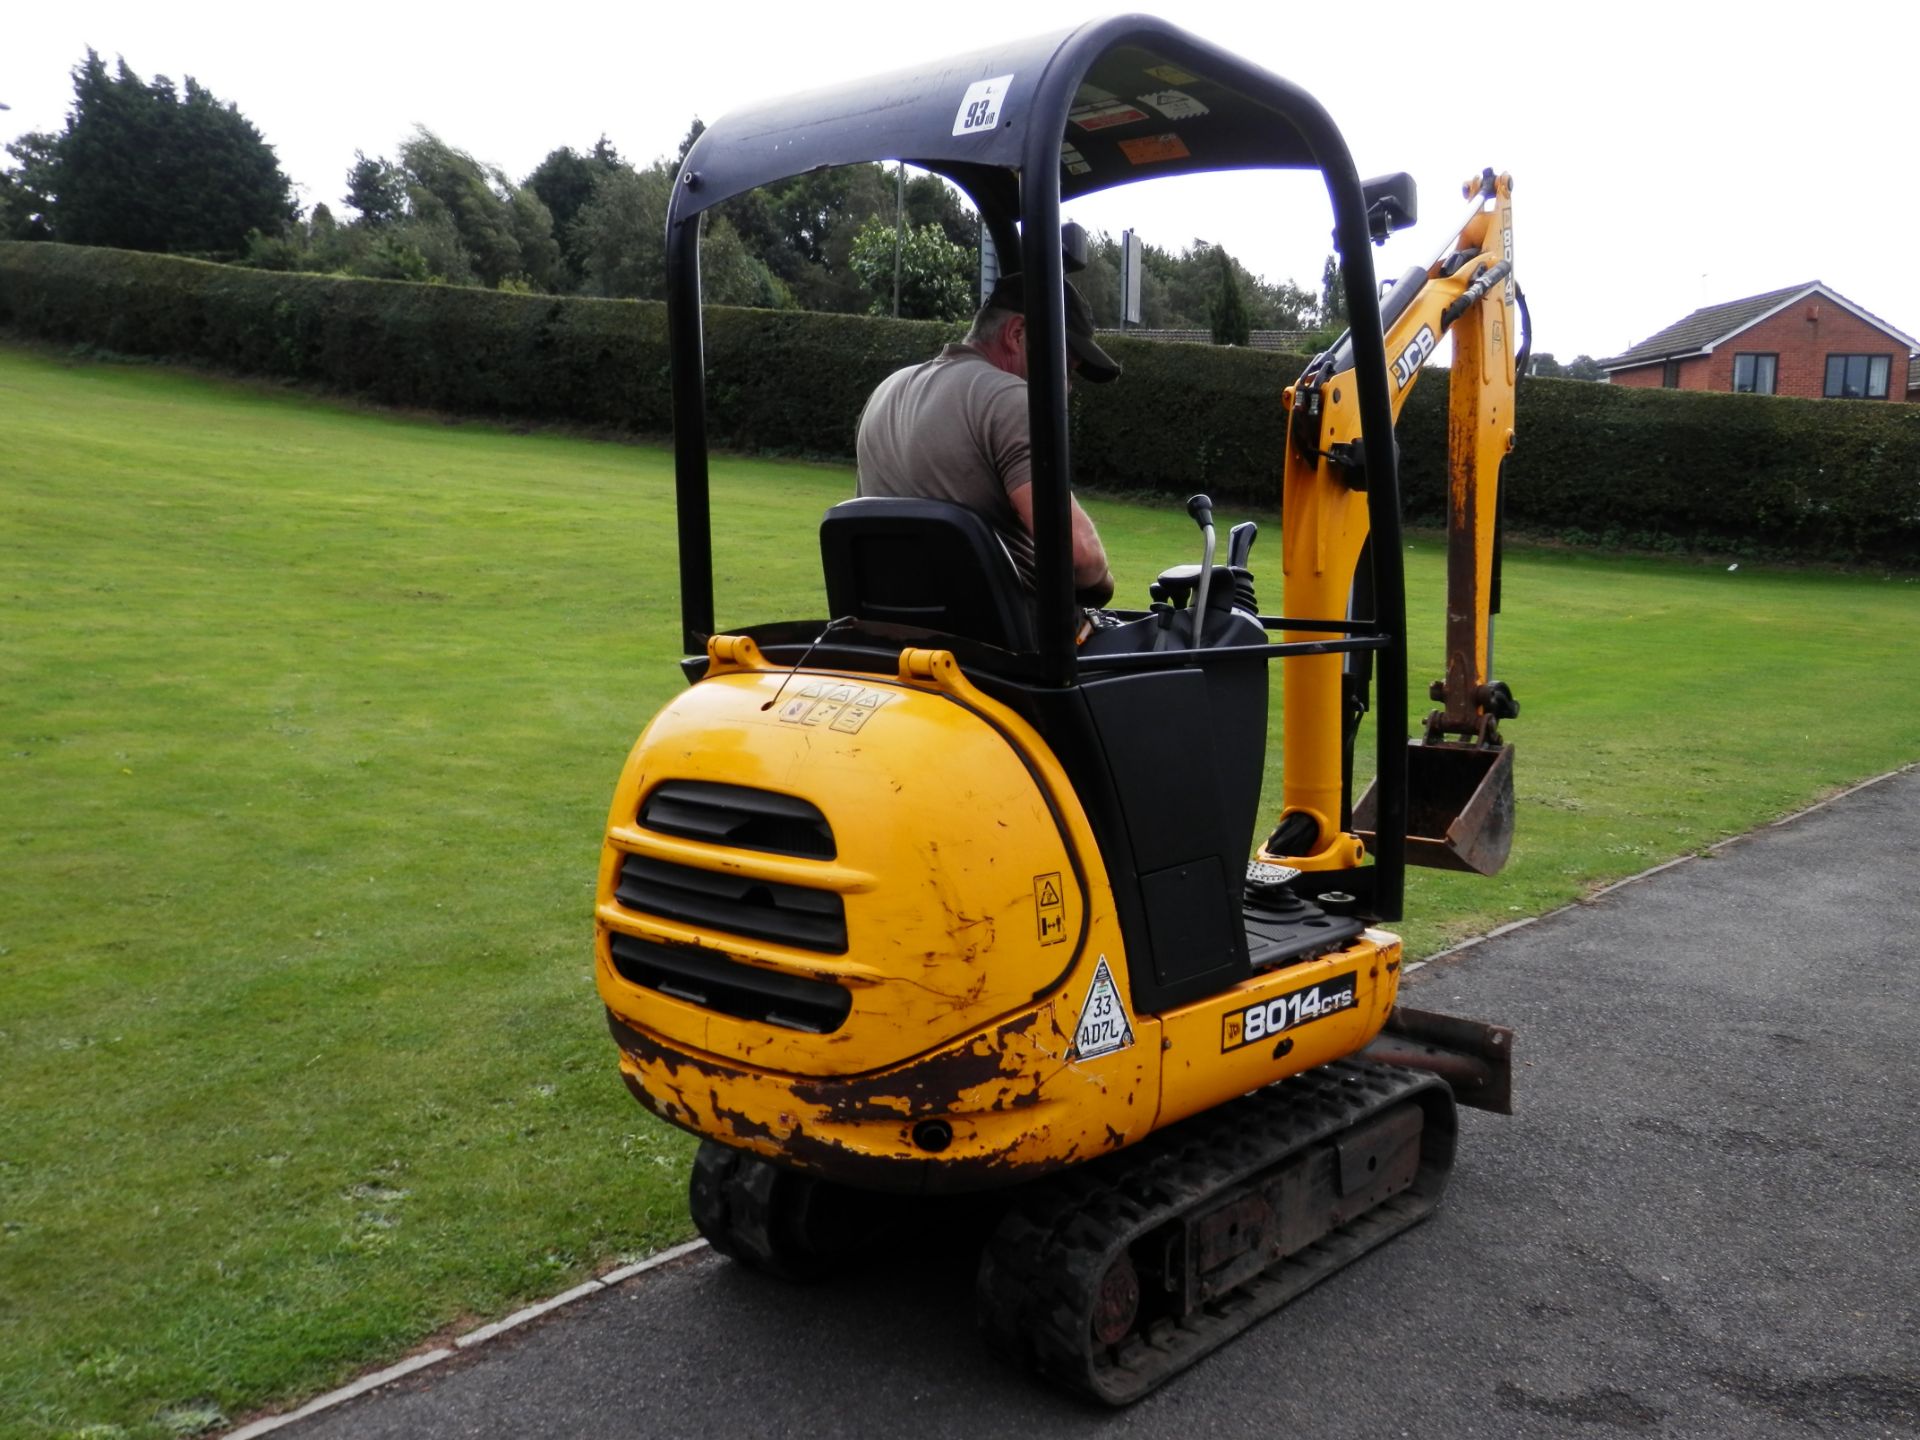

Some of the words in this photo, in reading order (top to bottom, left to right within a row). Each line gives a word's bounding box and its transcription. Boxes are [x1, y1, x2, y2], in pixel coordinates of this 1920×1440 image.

[1398, 327, 1435, 388] JCB
[1093, 994, 1111, 1018] 33
[1081, 1019, 1119, 1046] AD7L
